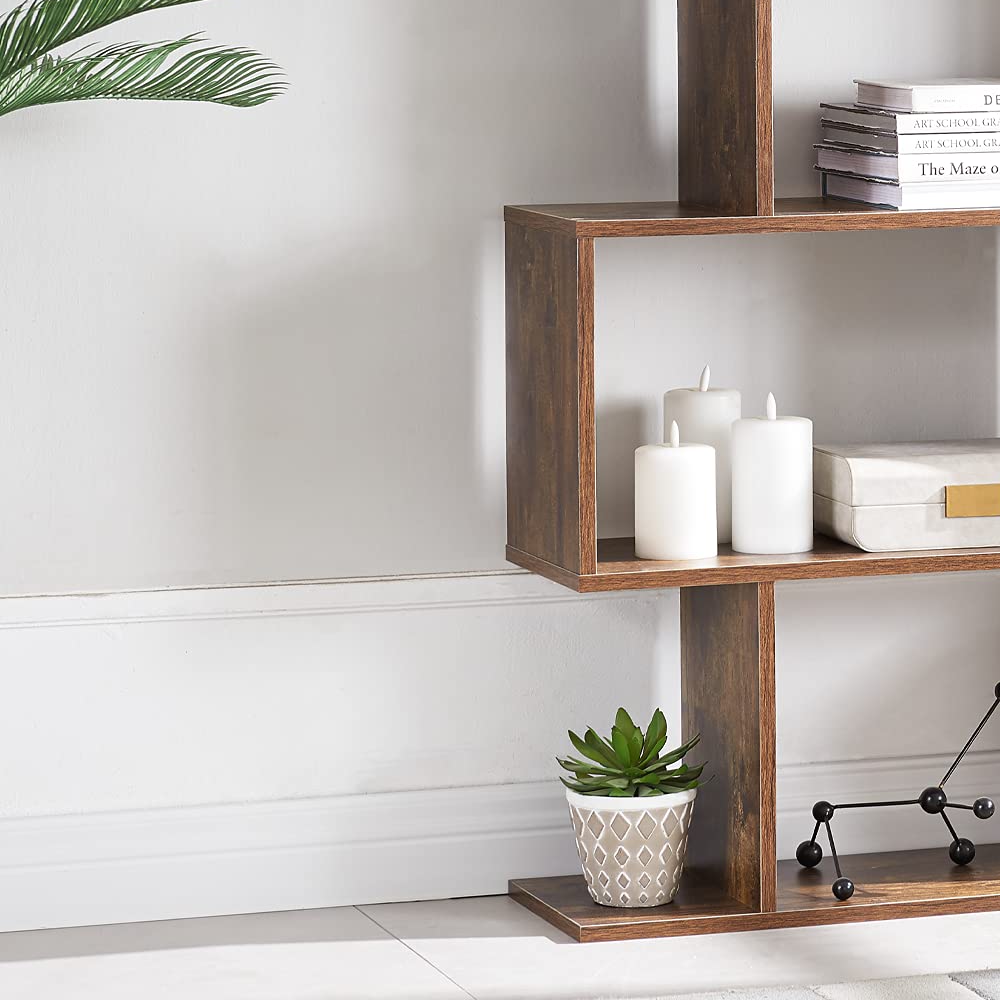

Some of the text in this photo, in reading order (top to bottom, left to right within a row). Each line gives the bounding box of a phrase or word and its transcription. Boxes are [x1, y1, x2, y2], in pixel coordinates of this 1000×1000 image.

[913, 118, 932, 129] ART
[934, 118, 980, 129] SCHOOL
[915, 139, 932, 149] ART
[936, 138, 981, 149] SCHOOL
[918, 162, 945, 176] The
[949, 161, 986, 176] Maze
